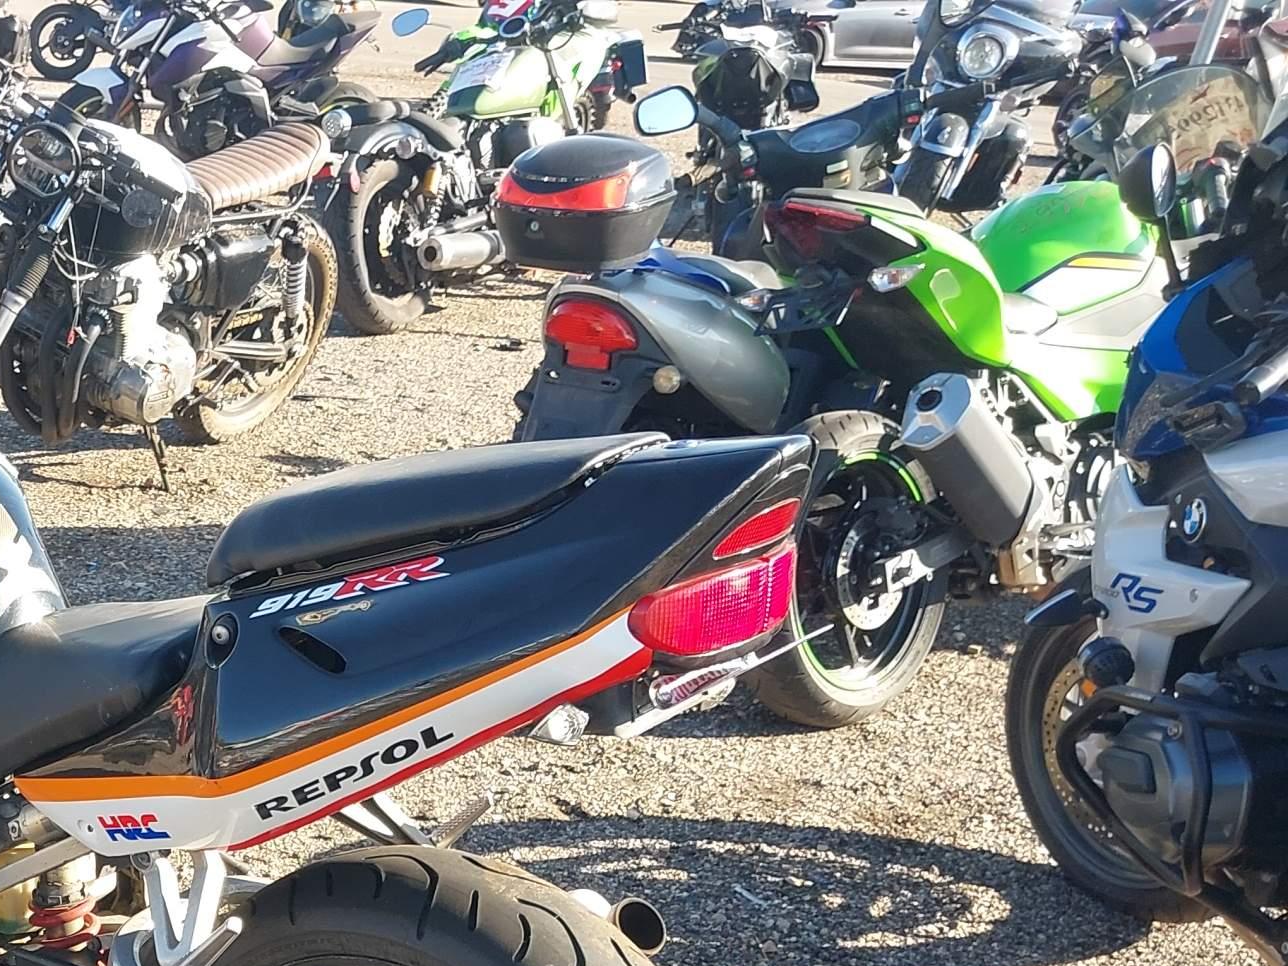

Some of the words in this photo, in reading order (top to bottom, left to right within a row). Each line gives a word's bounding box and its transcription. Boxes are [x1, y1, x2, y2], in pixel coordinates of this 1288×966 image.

[248, 555, 452, 619] 919RR
[1110, 572, 1164, 613] RS
[254, 726, 454, 820] REPSOL
[97, 814, 171, 842] HRC
